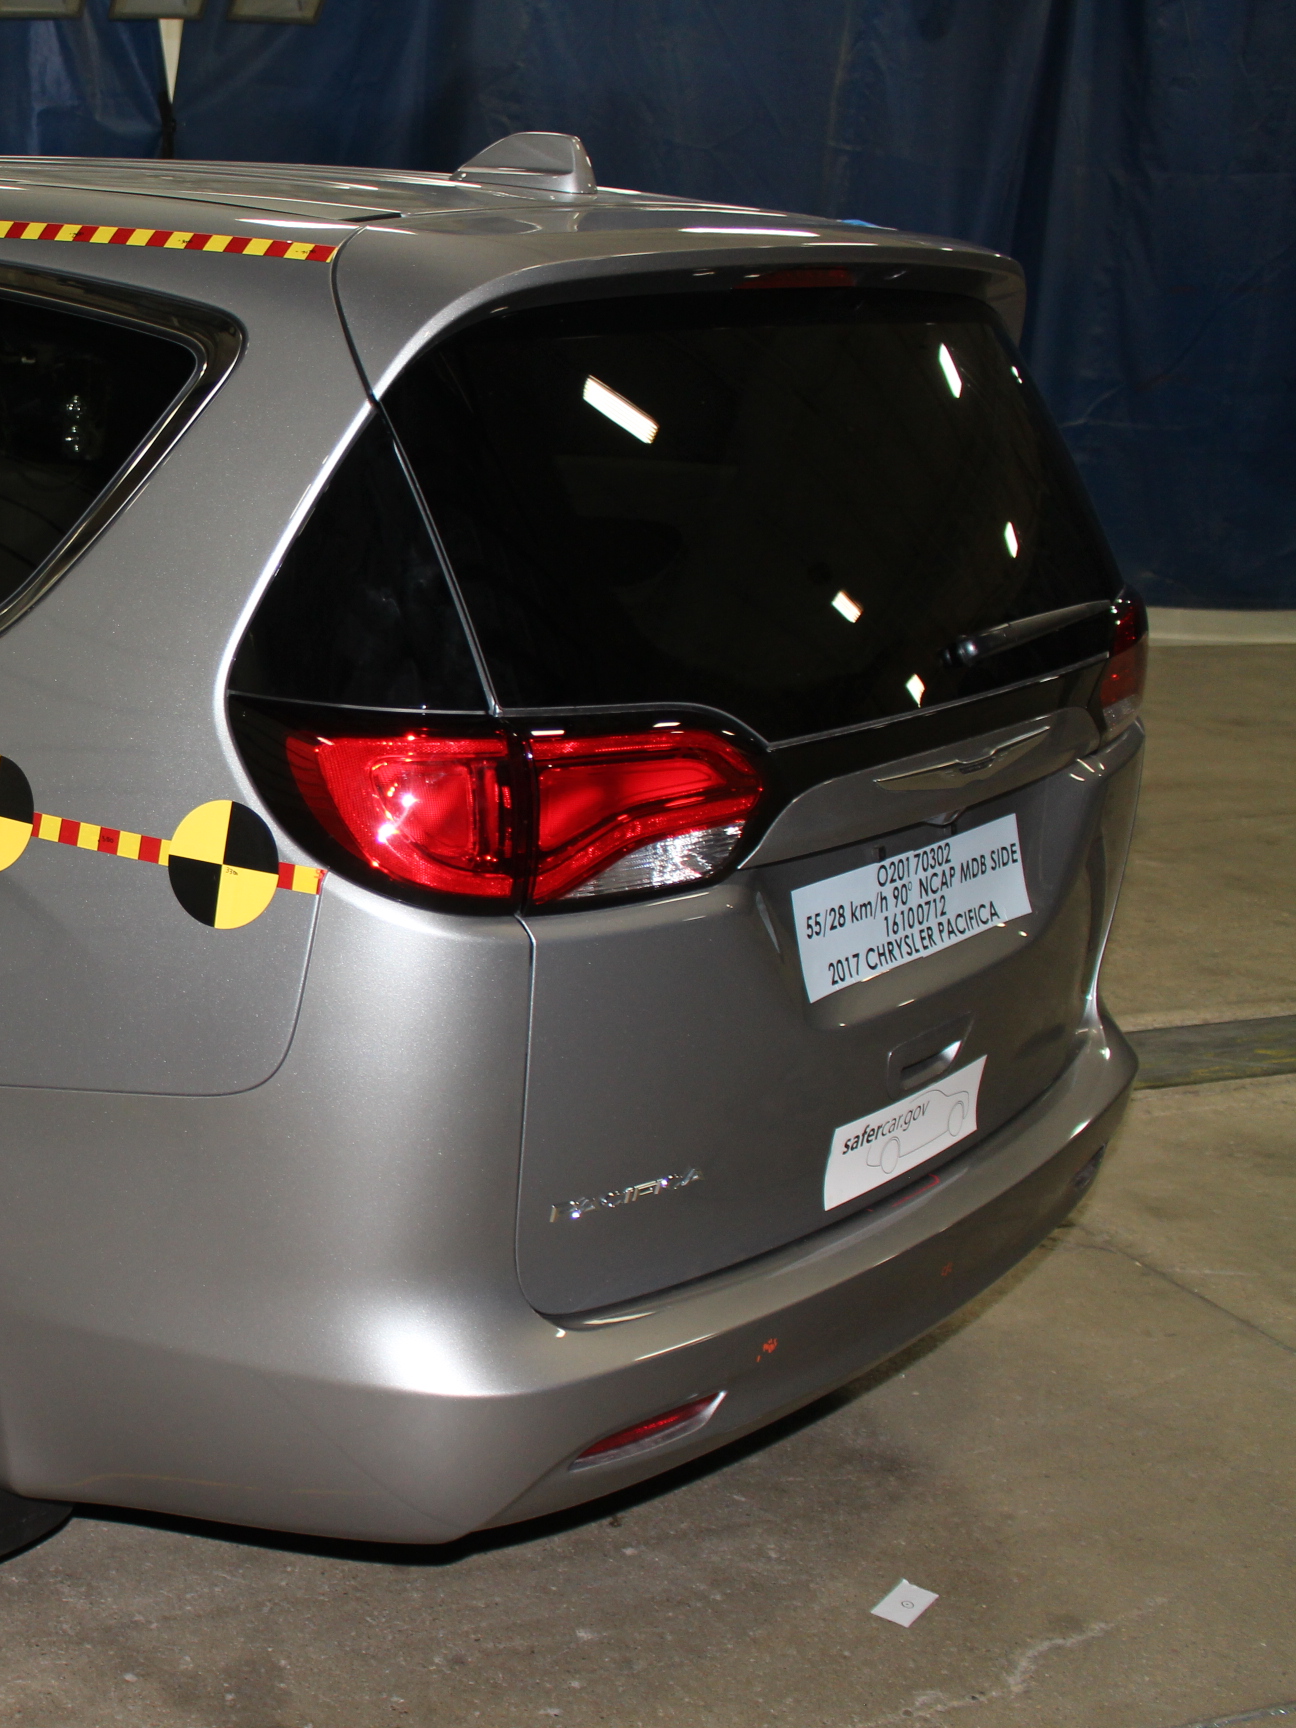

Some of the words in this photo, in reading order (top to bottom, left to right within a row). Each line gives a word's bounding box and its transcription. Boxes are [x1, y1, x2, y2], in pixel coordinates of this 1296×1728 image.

[806, 905, 847, 939] 55/28
[850, 892, 889, 924] km/h
[919, 867, 956, 899] NCAP
[960, 854, 987, 884] MDB
[990, 842, 1019, 872] SIDE
[883, 895, 947, 937] 16100712
[828, 953, 861, 986] 2017
[865, 926, 937, 971] CHRYSLER
[938, 900, 1000, 944] PACIFICA
[842, 1100, 931, 1155] safercar.gov
